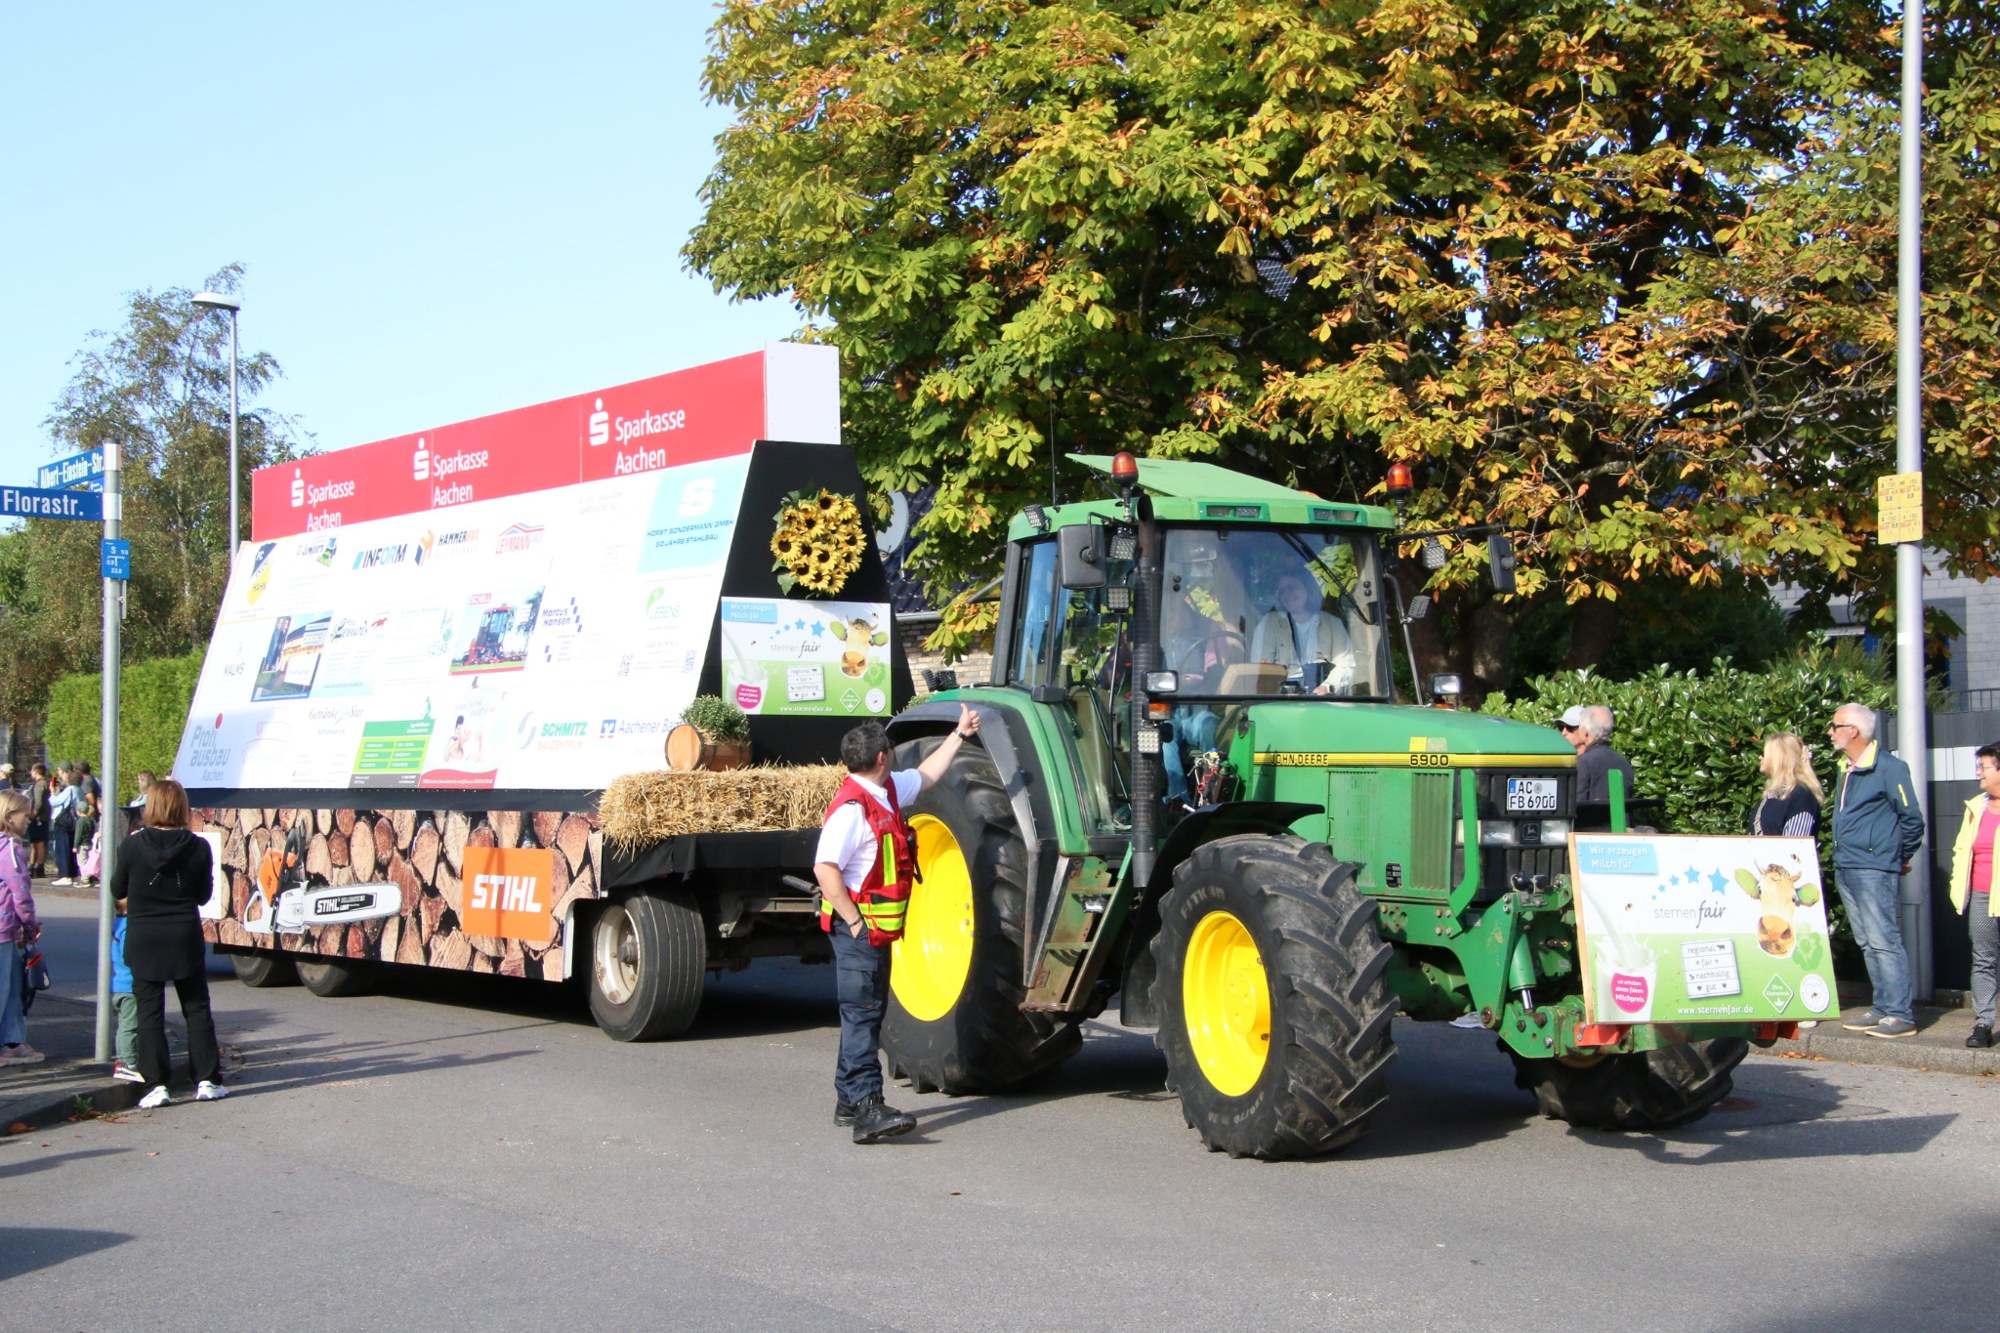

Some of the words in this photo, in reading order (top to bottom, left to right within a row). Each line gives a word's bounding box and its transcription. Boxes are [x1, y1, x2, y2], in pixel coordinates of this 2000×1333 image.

[615, 406, 686, 446] Sparkasse
[433, 448, 489, 478] Sparkasse
[615, 447, 666, 476] Aachen
[307, 478, 355, 506] Sparkasse
[433, 483, 473, 507] Aachen
[3, 489, 84, 517] Florastr.
[306, 510, 342, 532] Aachen
[646, 528, 667, 538] HORST
[668, 521, 714, 535] SONDERMANN
[685, 533, 719, 545] STAHLBAU
[362, 543, 408, 569] INFORM
[542, 607, 569, 618] Marcus
[540, 720, 588, 737] SCHMITZ
[618, 719, 660, 734] Aachener
[189, 746, 231, 767] ausbau
[1270, 754, 1297, 766] JOHN
[1298, 754, 1328, 766] DEERE
[1410, 754, 1449, 766] 6900
[1518, 781, 1533, 794] AC
[1510, 795, 1525, 809] FB
[1527, 795, 1556, 809] 6900
[1588, 844, 1606, 855] Wir
[1607, 846, 1648, 858] erzeugen
[1591, 858, 1617, 868] Milch
[1618, 859, 1632, 870] für
[471, 874, 543, 913] STIHL
[316, 898, 340, 914] STIHL
[1686, 944, 1716, 956] regional
[1700, 957, 1714, 967] fair
[1695, 968, 1730, 981] nachhaltig
[1705, 982, 1717, 993] gut
[1615, 993, 1645, 1003] Milchpreis
[1677, 1005, 1755, 1016] www.sternenfair.de
